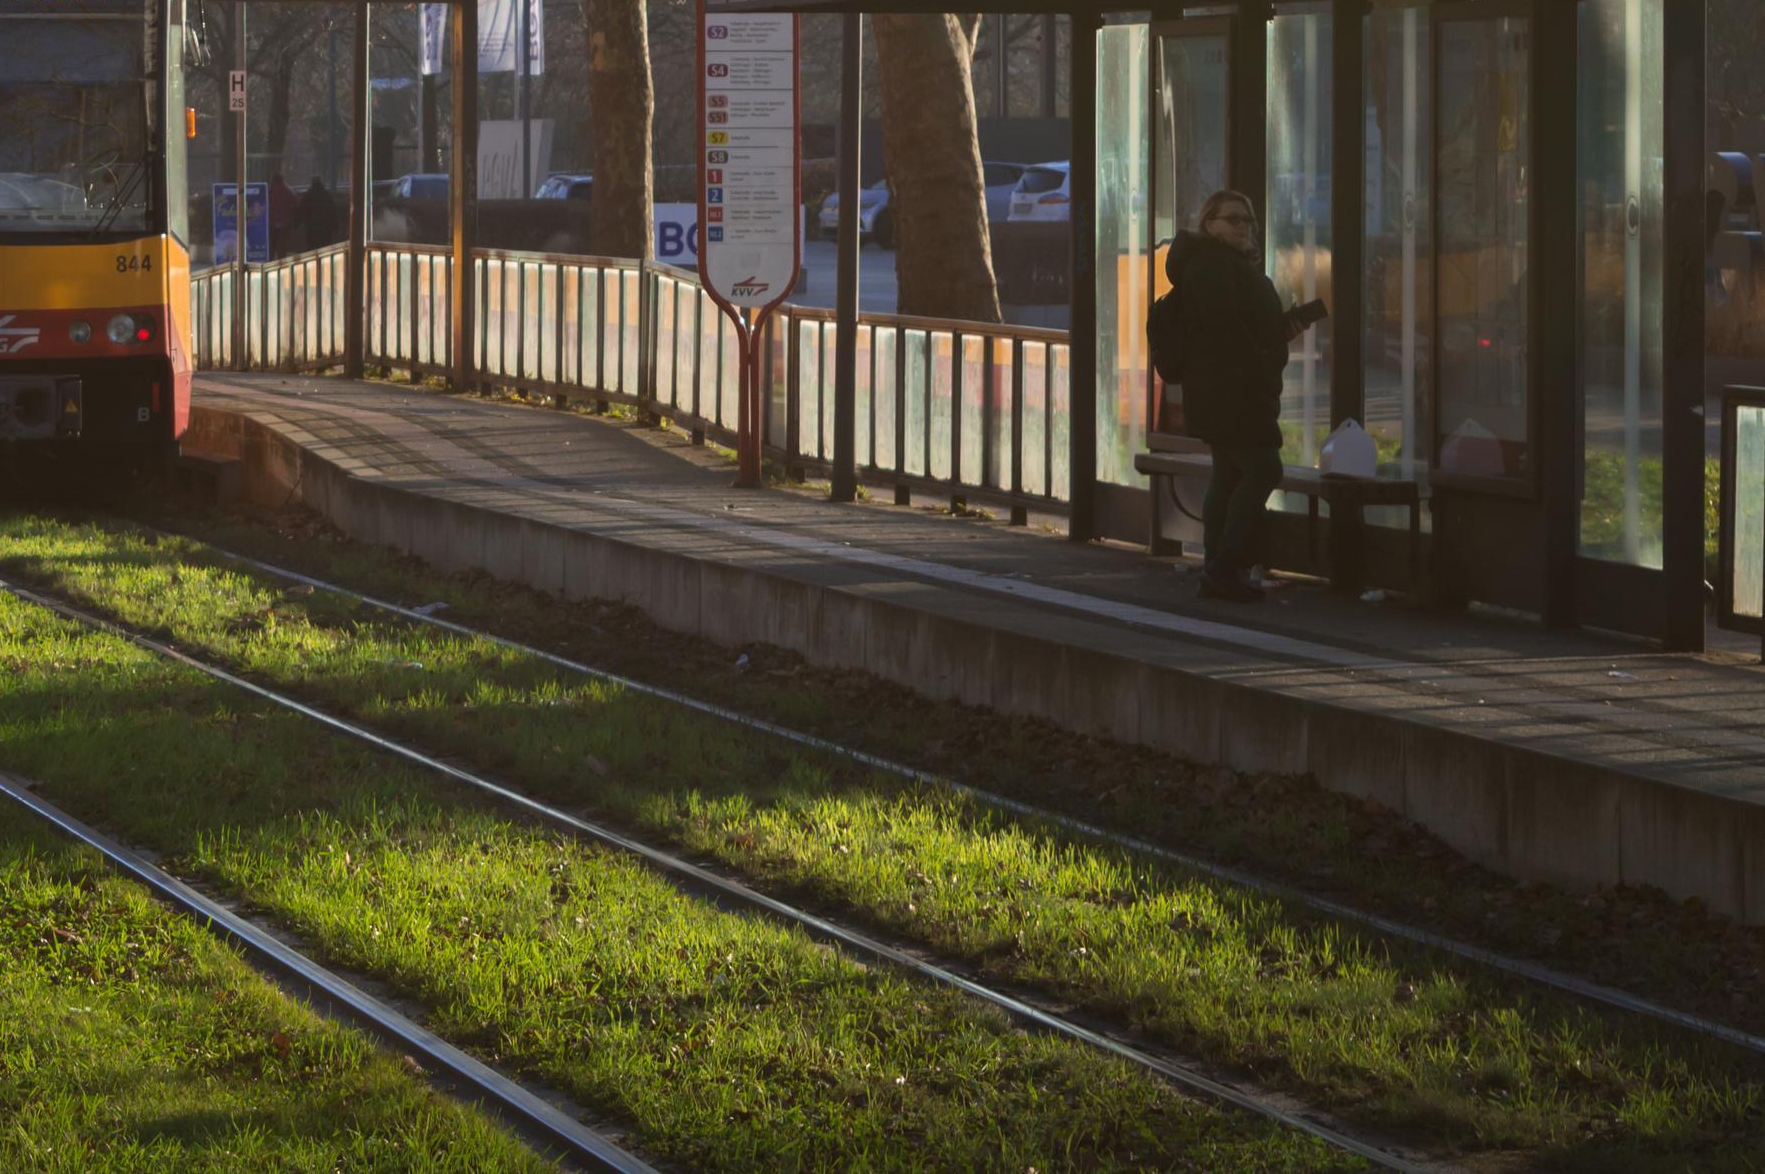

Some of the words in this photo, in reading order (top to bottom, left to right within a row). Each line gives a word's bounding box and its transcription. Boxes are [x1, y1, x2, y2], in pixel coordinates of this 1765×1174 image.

[711, 26, 725, 38] S2
[711, 66, 725, 76] S4
[232, 73, 244, 92] H
[711, 97, 724, 106] S5
[708, 112, 727, 123] S51
[711, 132, 725, 143] S7
[711, 152, 725, 163] S8
[711, 189, 719, 201] 2
[115, 254, 152, 273] 844
[731, 288, 754, 297] KVV
[137, 407, 150, 422] B
